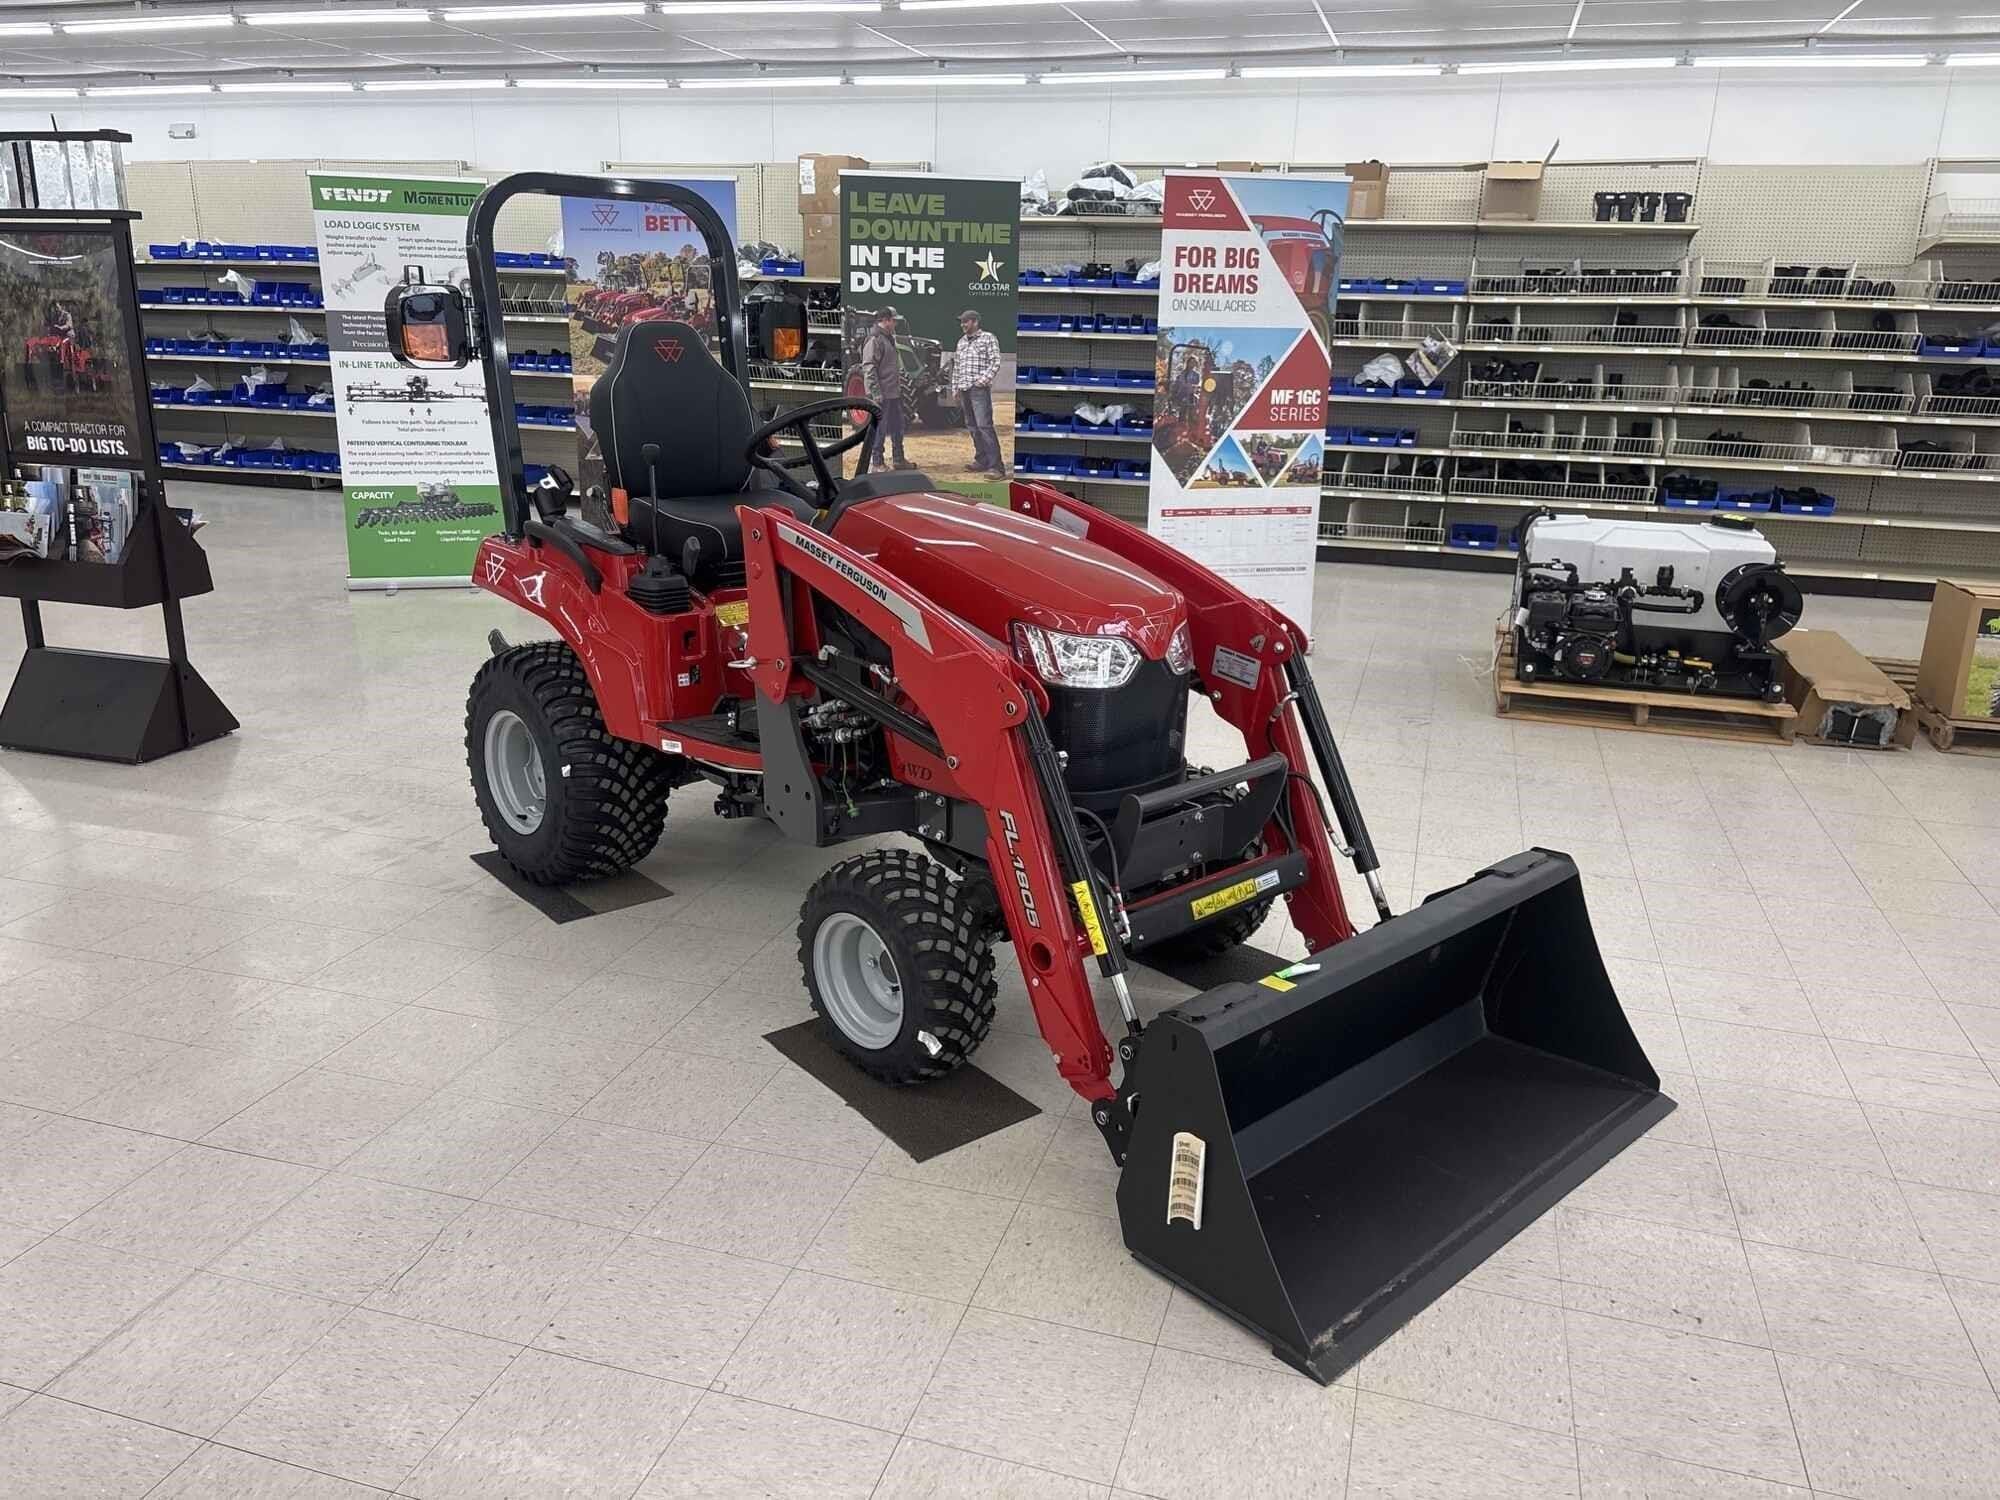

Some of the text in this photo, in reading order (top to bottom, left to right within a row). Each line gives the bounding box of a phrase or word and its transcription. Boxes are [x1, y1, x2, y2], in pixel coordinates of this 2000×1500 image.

[320, 187, 393, 203] FENDT
[850, 191, 945, 215] LEAVE
[324, 220, 420, 232] LOAD LOGIC SYSTEM
[645, 215, 699, 232] BETT
[849, 218, 1011, 244] DOWNTIME
[850, 245, 945, 268] IN THE
[1174, 246, 1260, 270] FOR BIG
[850, 271, 936, 295] DUST.
[968, 282, 1010, 292] GOLD STAR
[1173, 273, 1258, 295] DREAMS
[1172, 299, 1256, 313] ON SMALL ACRES
[338, 360, 374, 369] IN-LINE
[1270, 389, 1321, 405] MF 1GC
[1270, 407, 1321, 422] SERIES
[24, 420, 126, 436] A COMPACT TRACTOR FOR
[26, 435, 129, 456] BIG TO-DO LISTS.
[351, 490, 394, 500] CAPACITY
[795, 535, 888, 602] MASSEY FERGUSON
